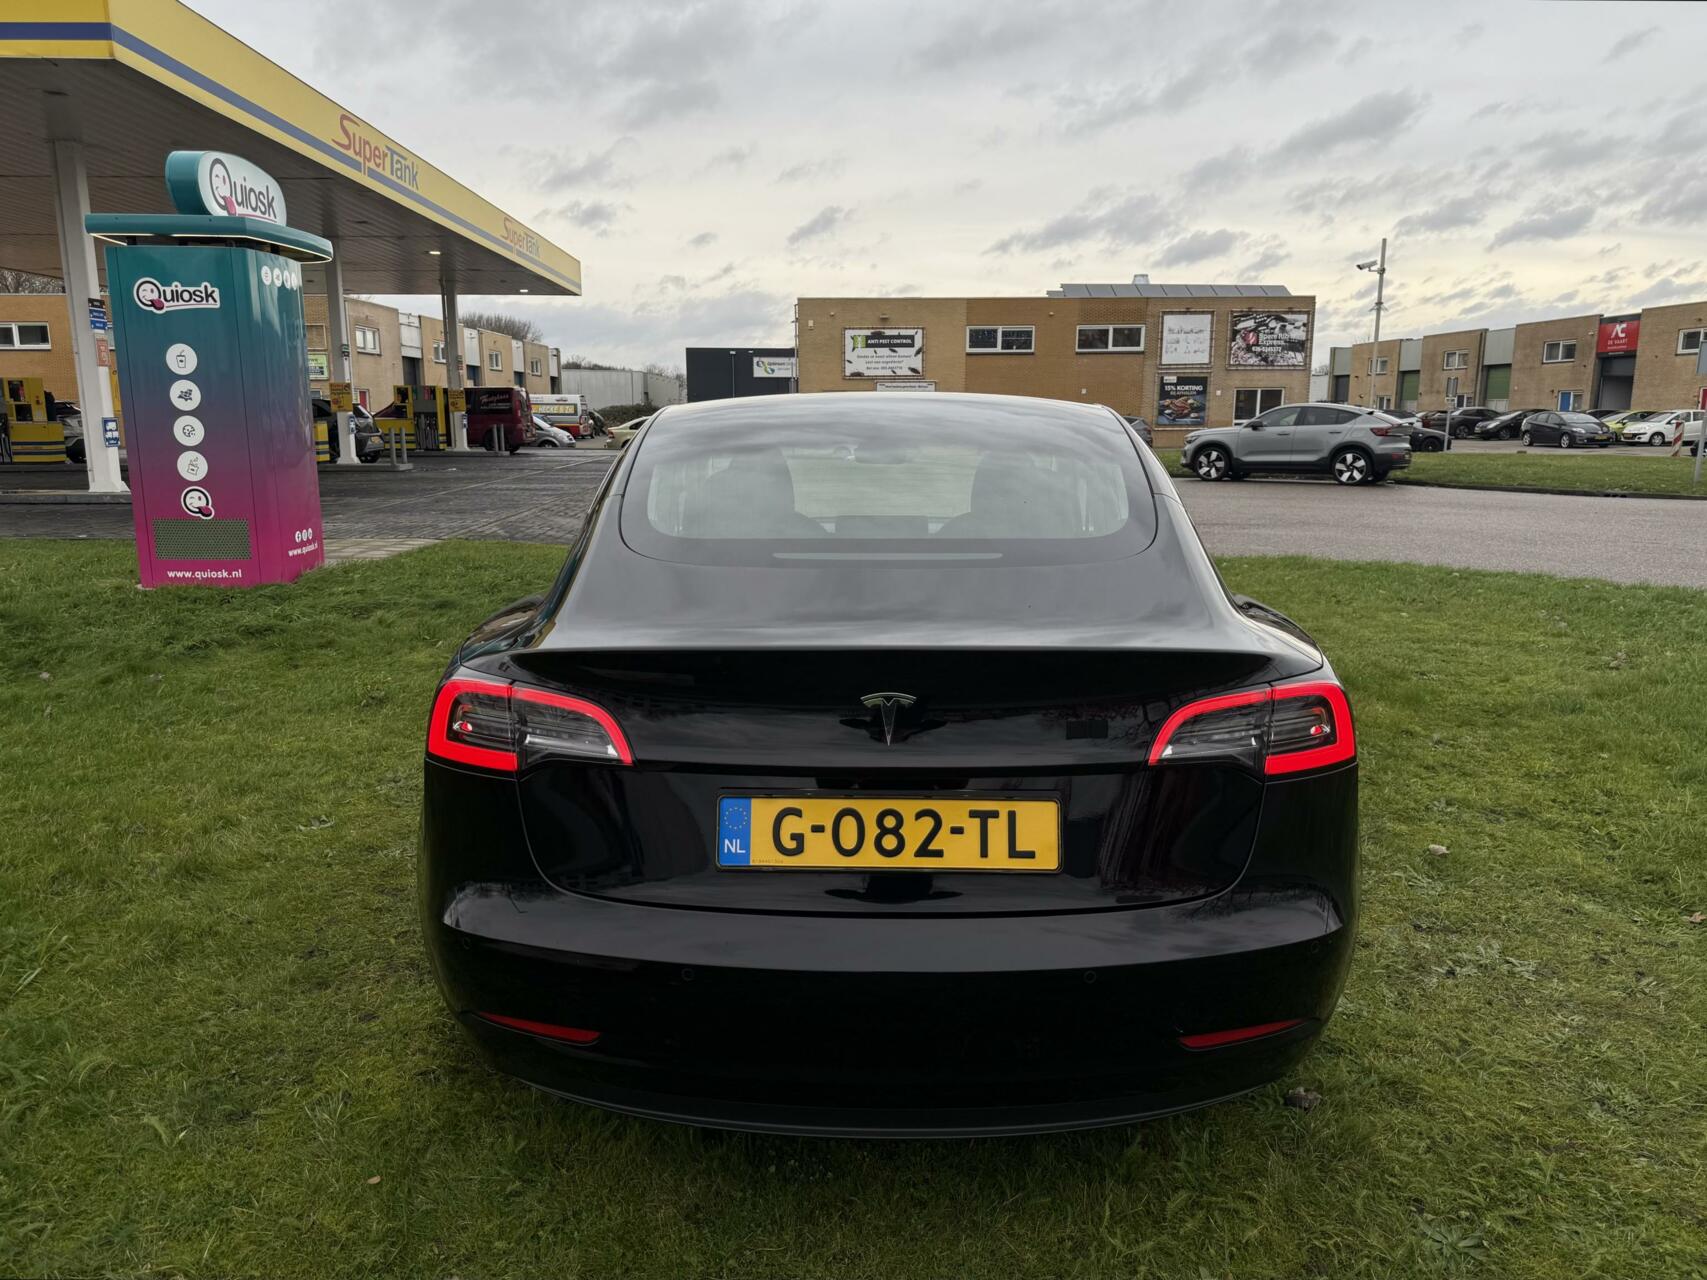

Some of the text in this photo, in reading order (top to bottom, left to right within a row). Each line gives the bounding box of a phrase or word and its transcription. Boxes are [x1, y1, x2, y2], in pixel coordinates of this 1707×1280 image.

[331, 113, 419, 191] SuperTank
[209, 157, 277, 219] Quiosk
[500, 216, 541, 258] SuperTank
[136, 281, 217, 310] Quiosk
[167, 569, 242, 580] www.quiosk.nl
[723, 838, 747, 853] NL
[772, 806, 1036, 859] G-082-TL
